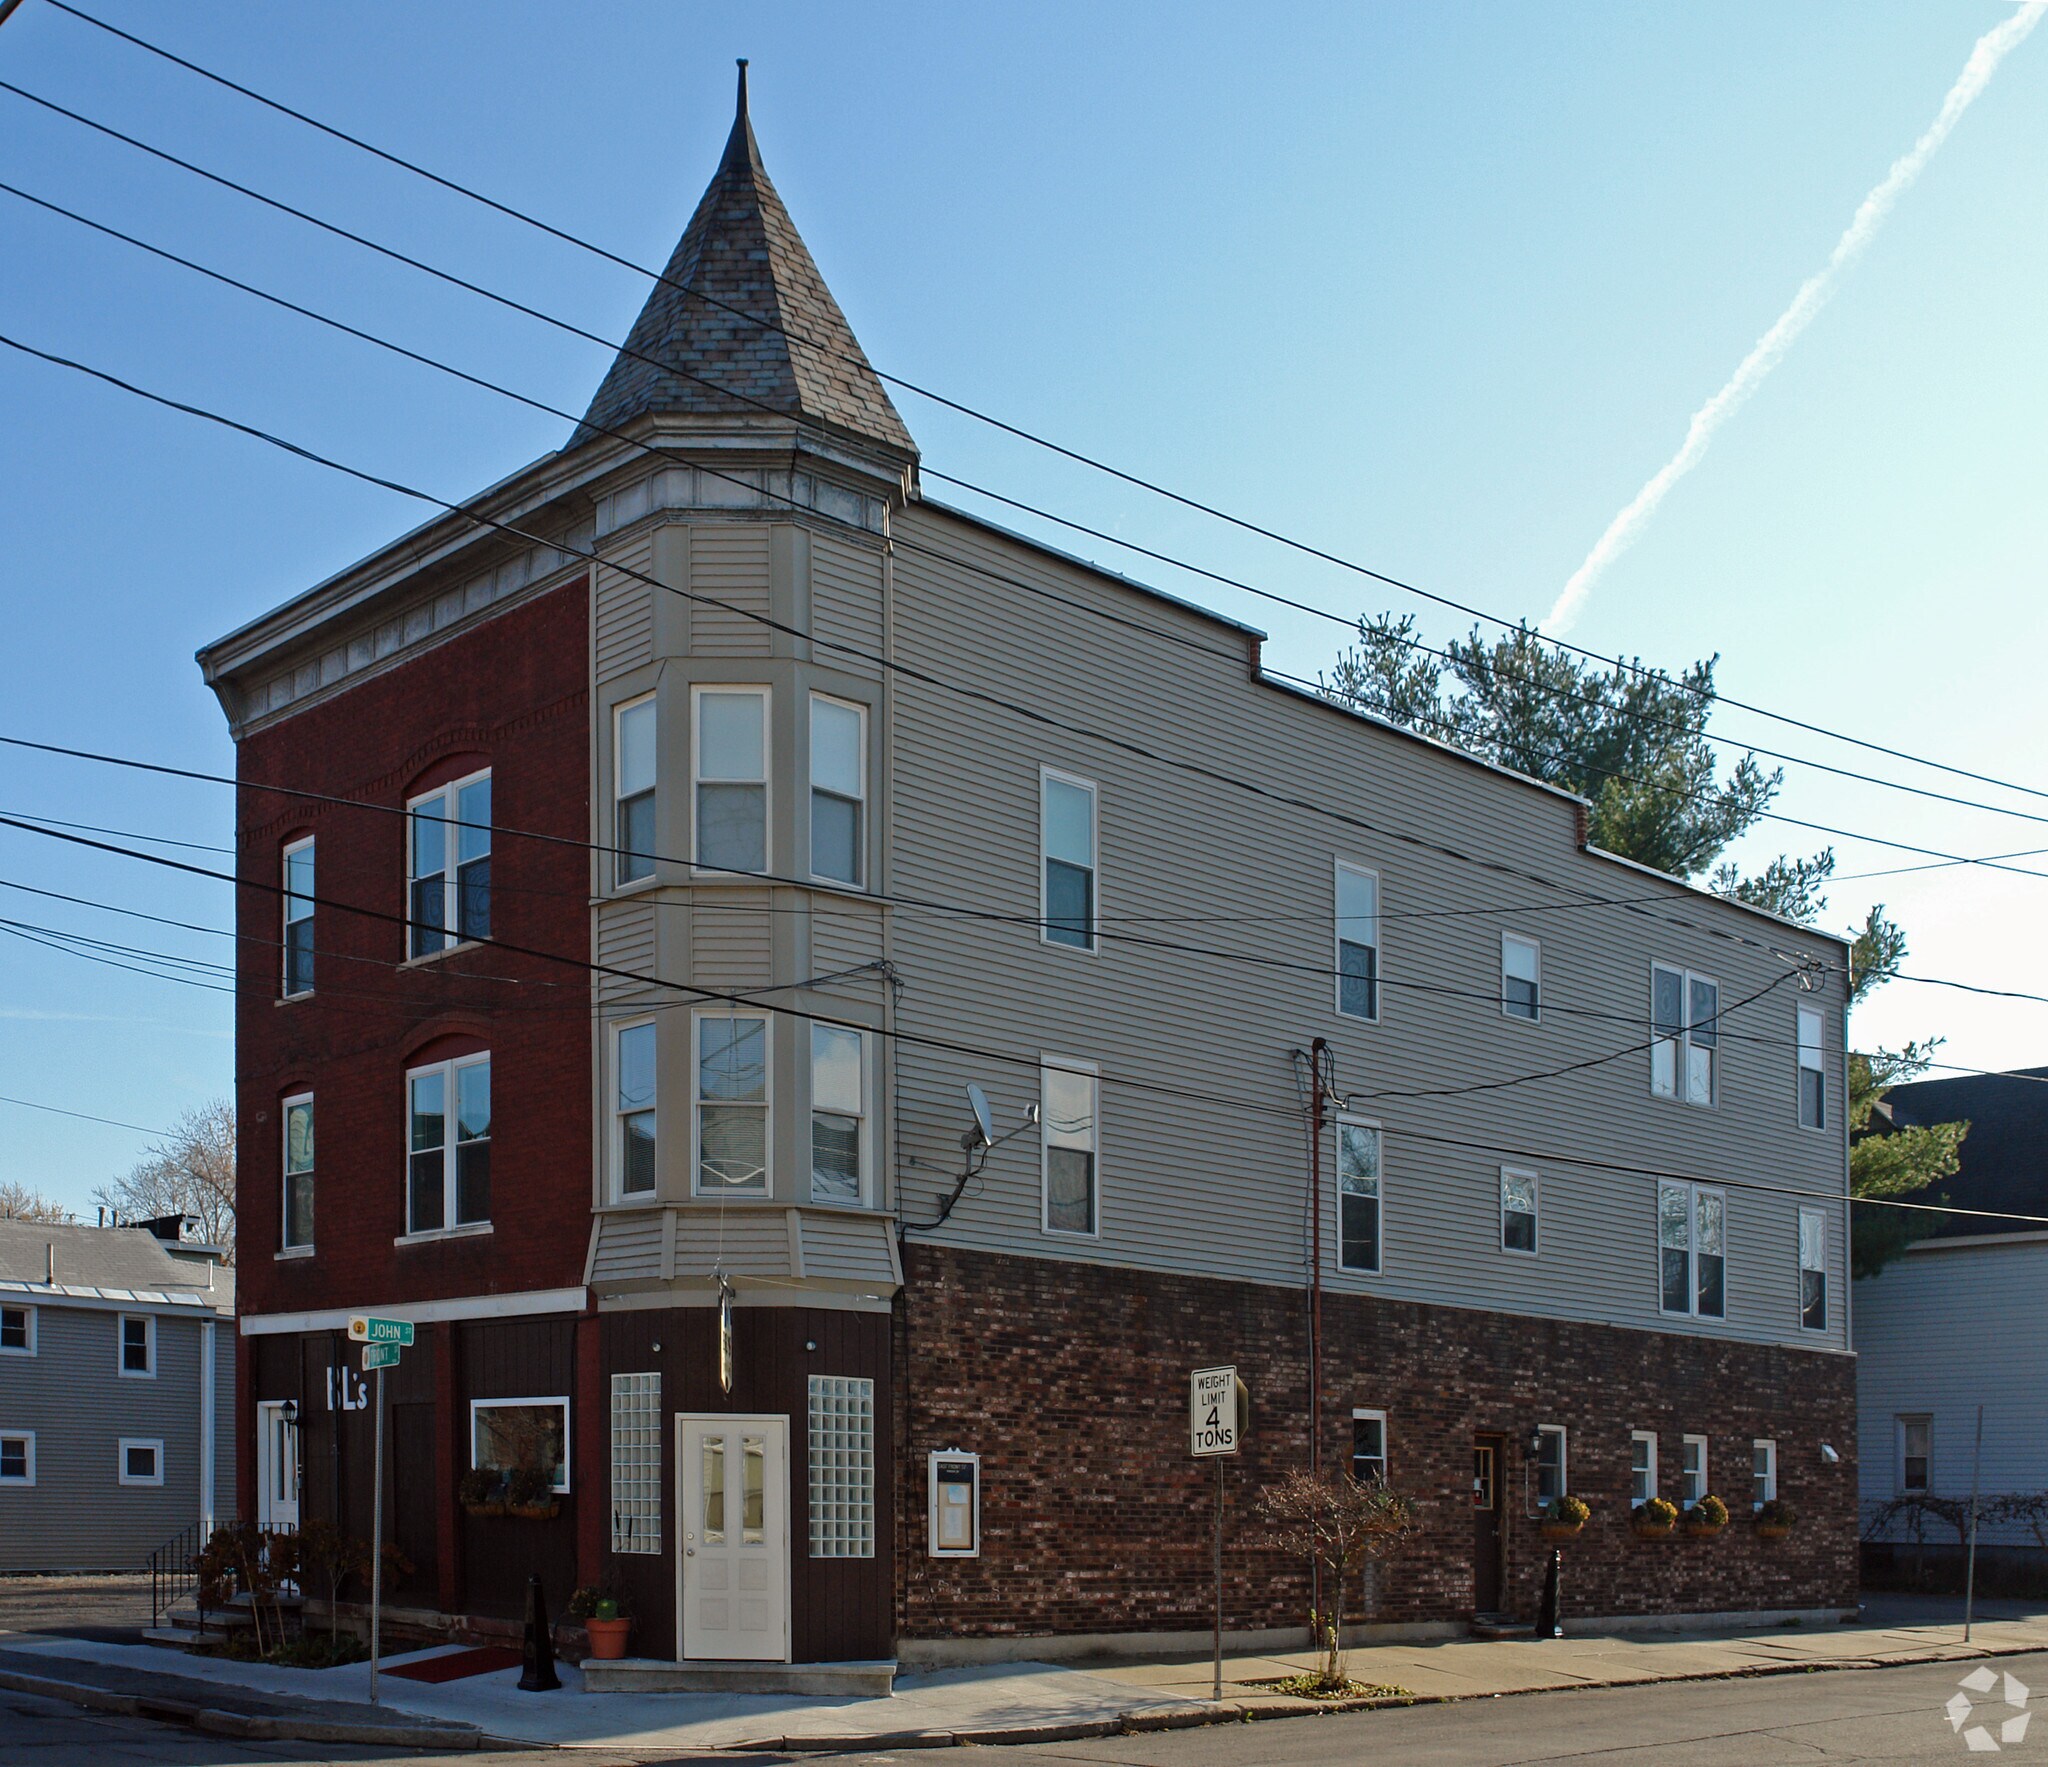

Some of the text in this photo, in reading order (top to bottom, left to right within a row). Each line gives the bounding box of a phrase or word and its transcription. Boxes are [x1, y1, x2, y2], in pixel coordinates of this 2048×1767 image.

[371, 1323, 401, 1339] JOHN
[1198, 1374, 1231, 1390] WEIGHT
[1202, 1391, 1226, 1406] LIMIT
[1206, 1406, 1220, 1429] 4
[1196, 1429, 1233, 1448] TONS
